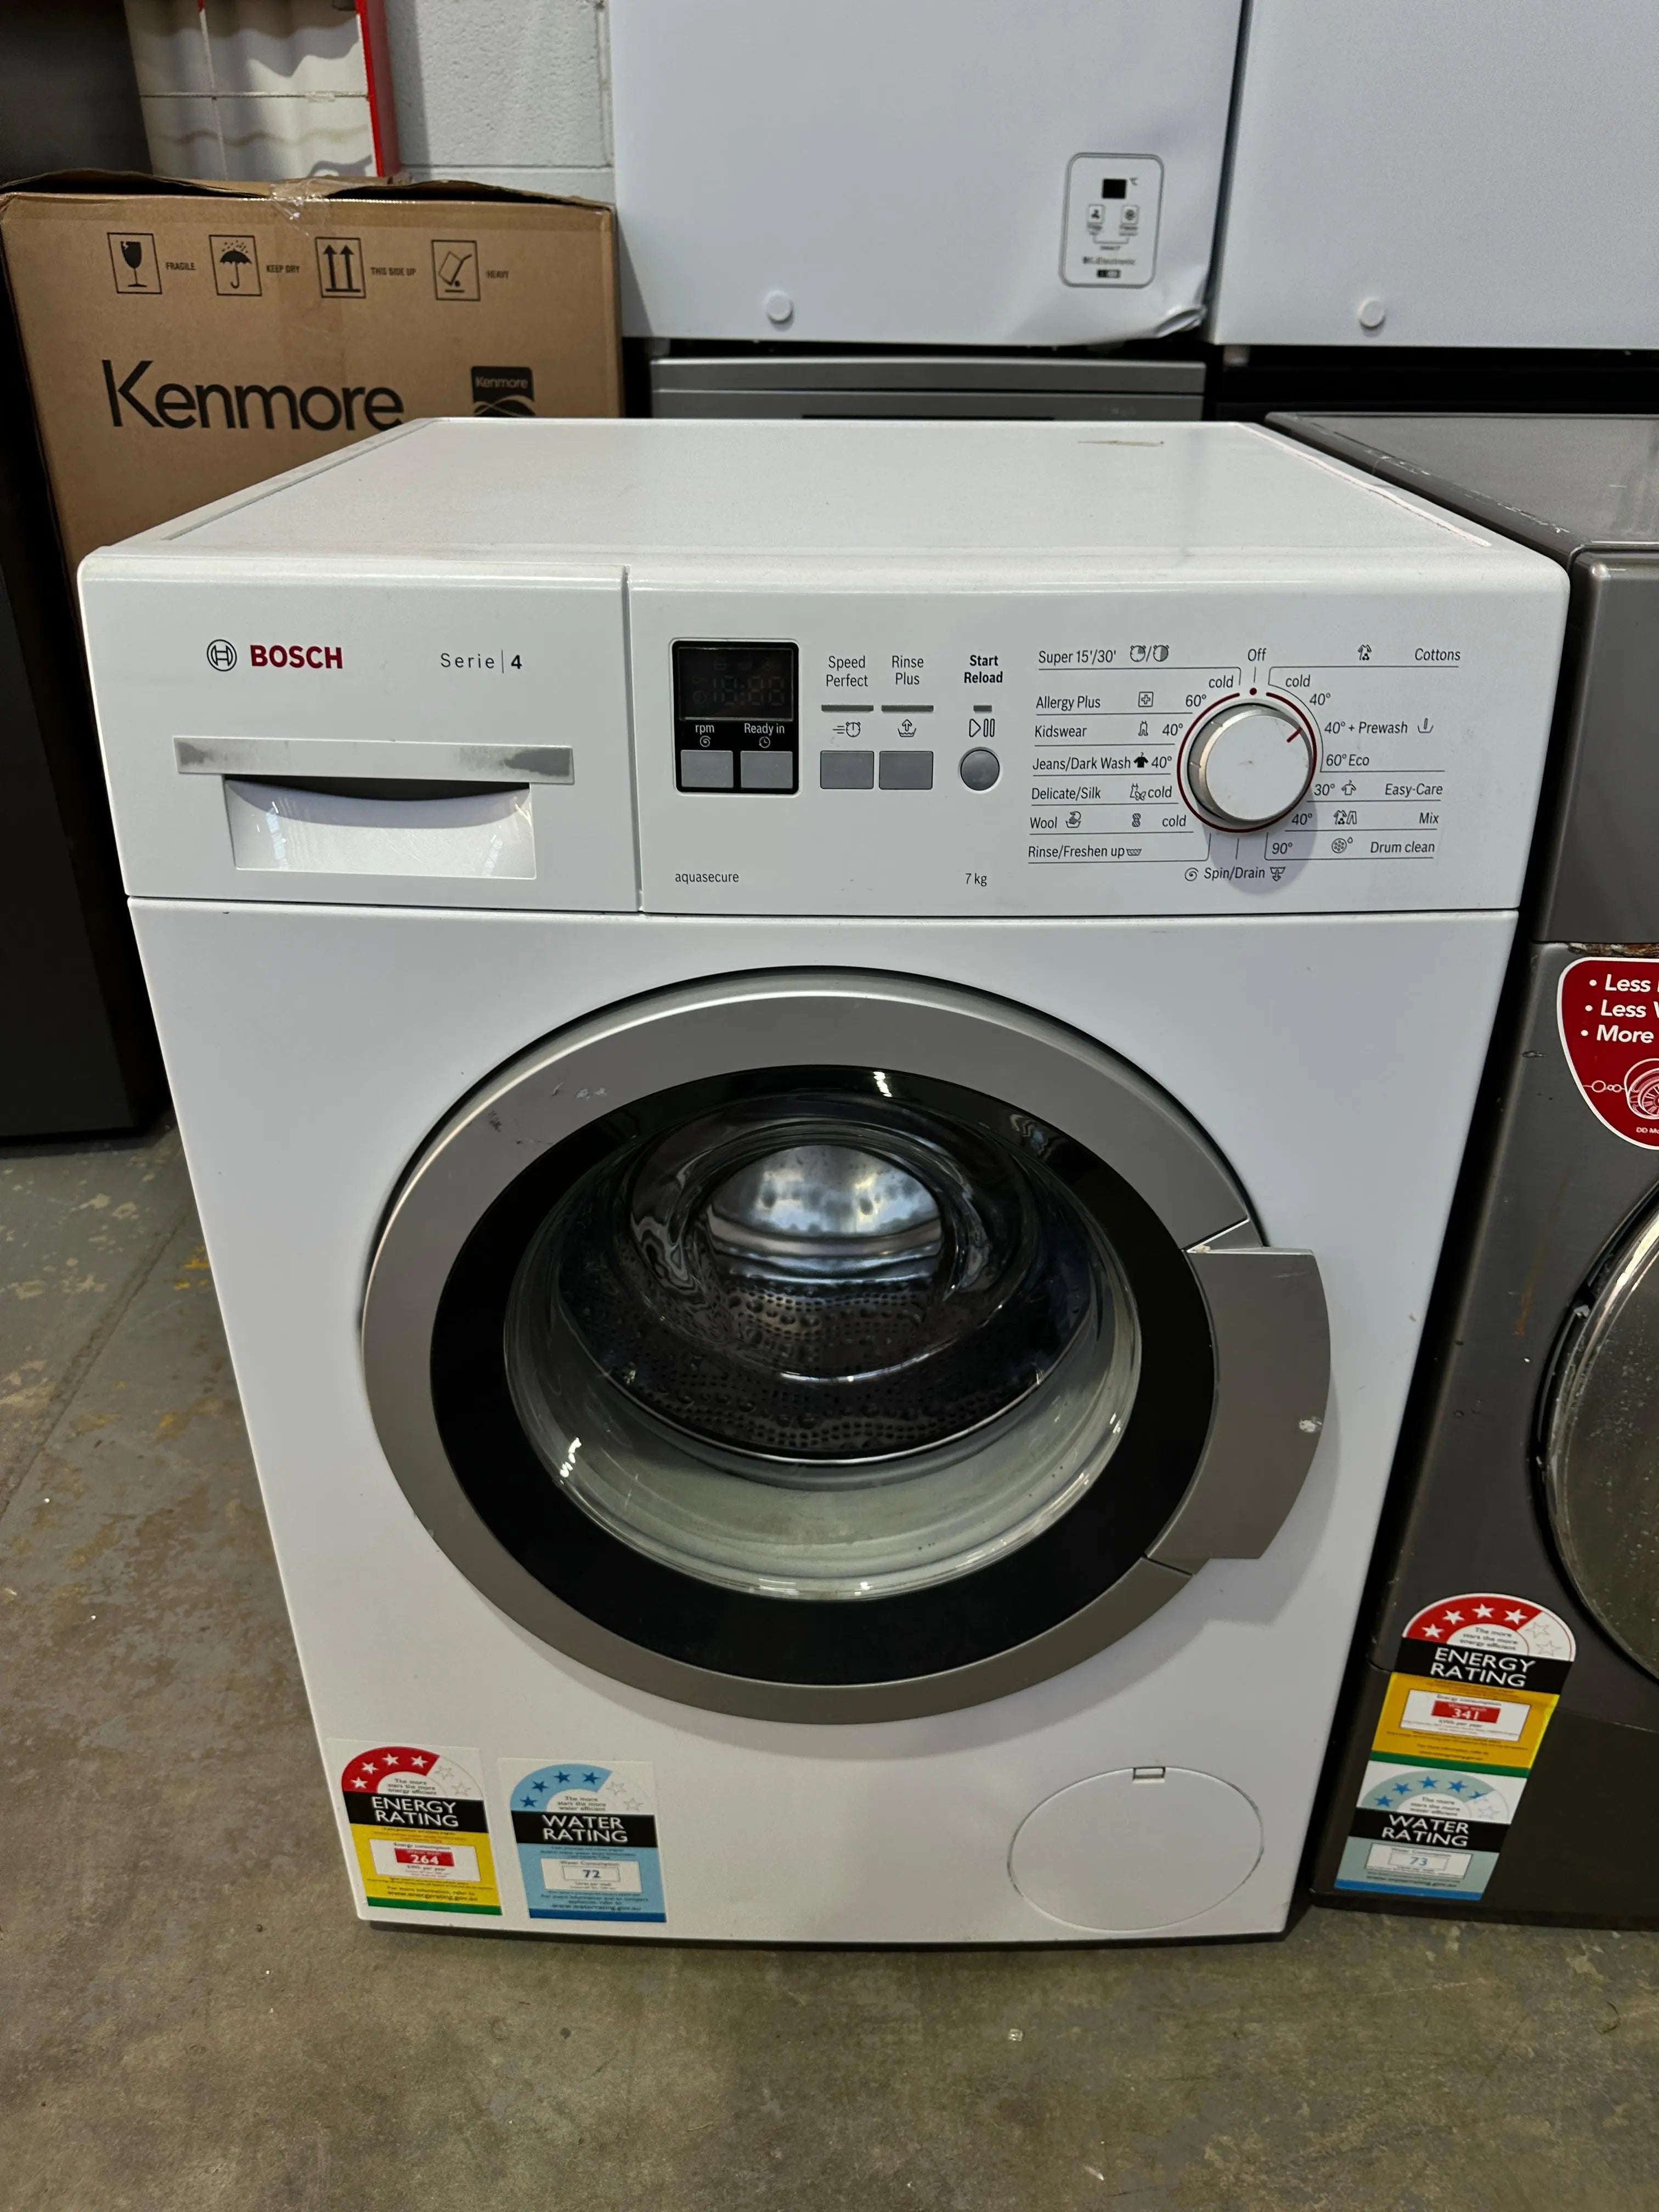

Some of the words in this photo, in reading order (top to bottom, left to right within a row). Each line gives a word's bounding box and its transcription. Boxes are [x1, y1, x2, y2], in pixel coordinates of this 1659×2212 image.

[166, 262, 196, 270] FRAGILE
[267, 264, 283, 273] KEEP
[371, 267, 387, 276] THIS
[389, 268, 405, 276] SIDE
[407, 268, 416, 276] UP
[487, 270, 509, 279] HEAVY
[475, 376, 529, 390] Kenmore
[102, 359, 404, 431] Kenmore
[250, 645, 343, 669] BOSCH
[441, 652, 494, 668] Serie
[511, 654, 522, 669] 4
[969, 654, 998, 667] Start
[1039, 651, 1074, 665] Super
[1076, 650, 1116, 665] 15'/30'
[1248, 648, 1266, 661] Off
[1415, 648, 1460, 661] Cottons
[828, 654, 866, 670] Speed
[891, 655, 924, 669] Rinse
[826, 673, 868, 687] Perfect
[895, 673, 919, 686] Plus
[964, 672, 1003, 684] Reload
[1209, 675, 1234, 688] cold
[1285, 675, 1311, 687] cold
[1036, 696, 1074, 711] Allergy
[1077, 696, 1101, 709] Plus
[695, 724, 715, 735] rpm
[744, 723, 774, 736] Ready
[776, 724, 785, 733] in
[1035, 725, 1087, 738] Kidswear
[1358, 721, 1408, 734] Prewash
[1032, 756, 1097, 770] Jeans/Dark
[1101, 757, 1131, 769] Wash
[1348, 754, 1369, 766] Eco
[1031, 786, 1101, 800] Delicate/Silk
[1148, 786, 1172, 798] cold
[1385, 783, 1443, 798] Easy-Care
[1030, 816, 1057, 829] Wool
[1162, 815, 1187, 827] cold
[1419, 812, 1439, 825] Mix
[1028, 845, 1108, 859] Rinse/Freshen
[1110, 848, 1125, 859] up
[1370, 840, 1403, 853] Drum
[1405, 840, 1435, 853] clean
[675, 872, 739, 884] aquasecure
[965, 873, 972, 884] 7
[974, 873, 988, 887] kg
[1204, 866, 1265, 881] Spin/Drain
[1605, 974, 1651, 992] Less
[1601, 999, 1646, 1018] Less
[1596, 1024, 1654, 1043] More
[1435, 1647, 1536, 1673] ENERGY
[1430, 1662, 1527, 1688] RATING
[1452, 1708, 1480, 1720] 341
[371, 1796, 456, 1814] ENERGY
[376, 1810, 459, 1827] RATING
[542, 1814, 624, 1829] WATER
[1389, 1814, 1469, 1835] WATER
[543, 1828, 628, 1843] RATING
[1381, 1827, 1469, 1847] RATING
[411, 1854, 439, 1865] 264
[1409, 1857, 1428, 1866] 73
[583, 1869, 601, 1878] 72
